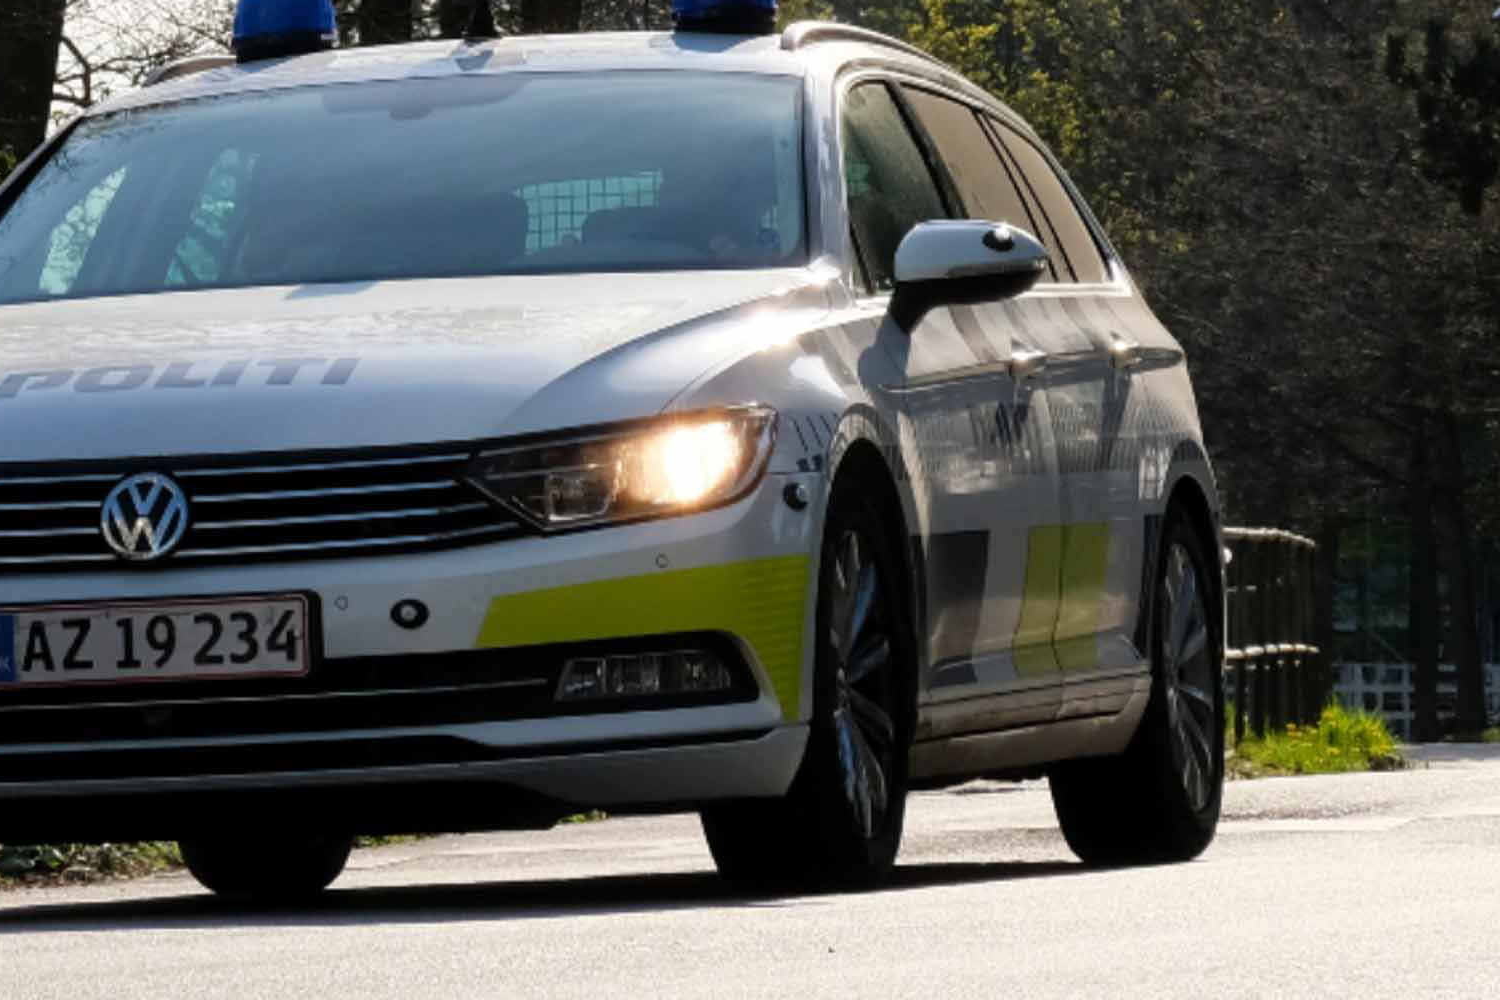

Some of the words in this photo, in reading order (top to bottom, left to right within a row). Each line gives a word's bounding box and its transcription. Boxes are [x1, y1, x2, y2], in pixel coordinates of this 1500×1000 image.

[104, 475, 184, 556] VW
[21, 618, 94, 672] AZ
[116, 613, 177, 669] 19
[193, 607, 302, 665] 234
